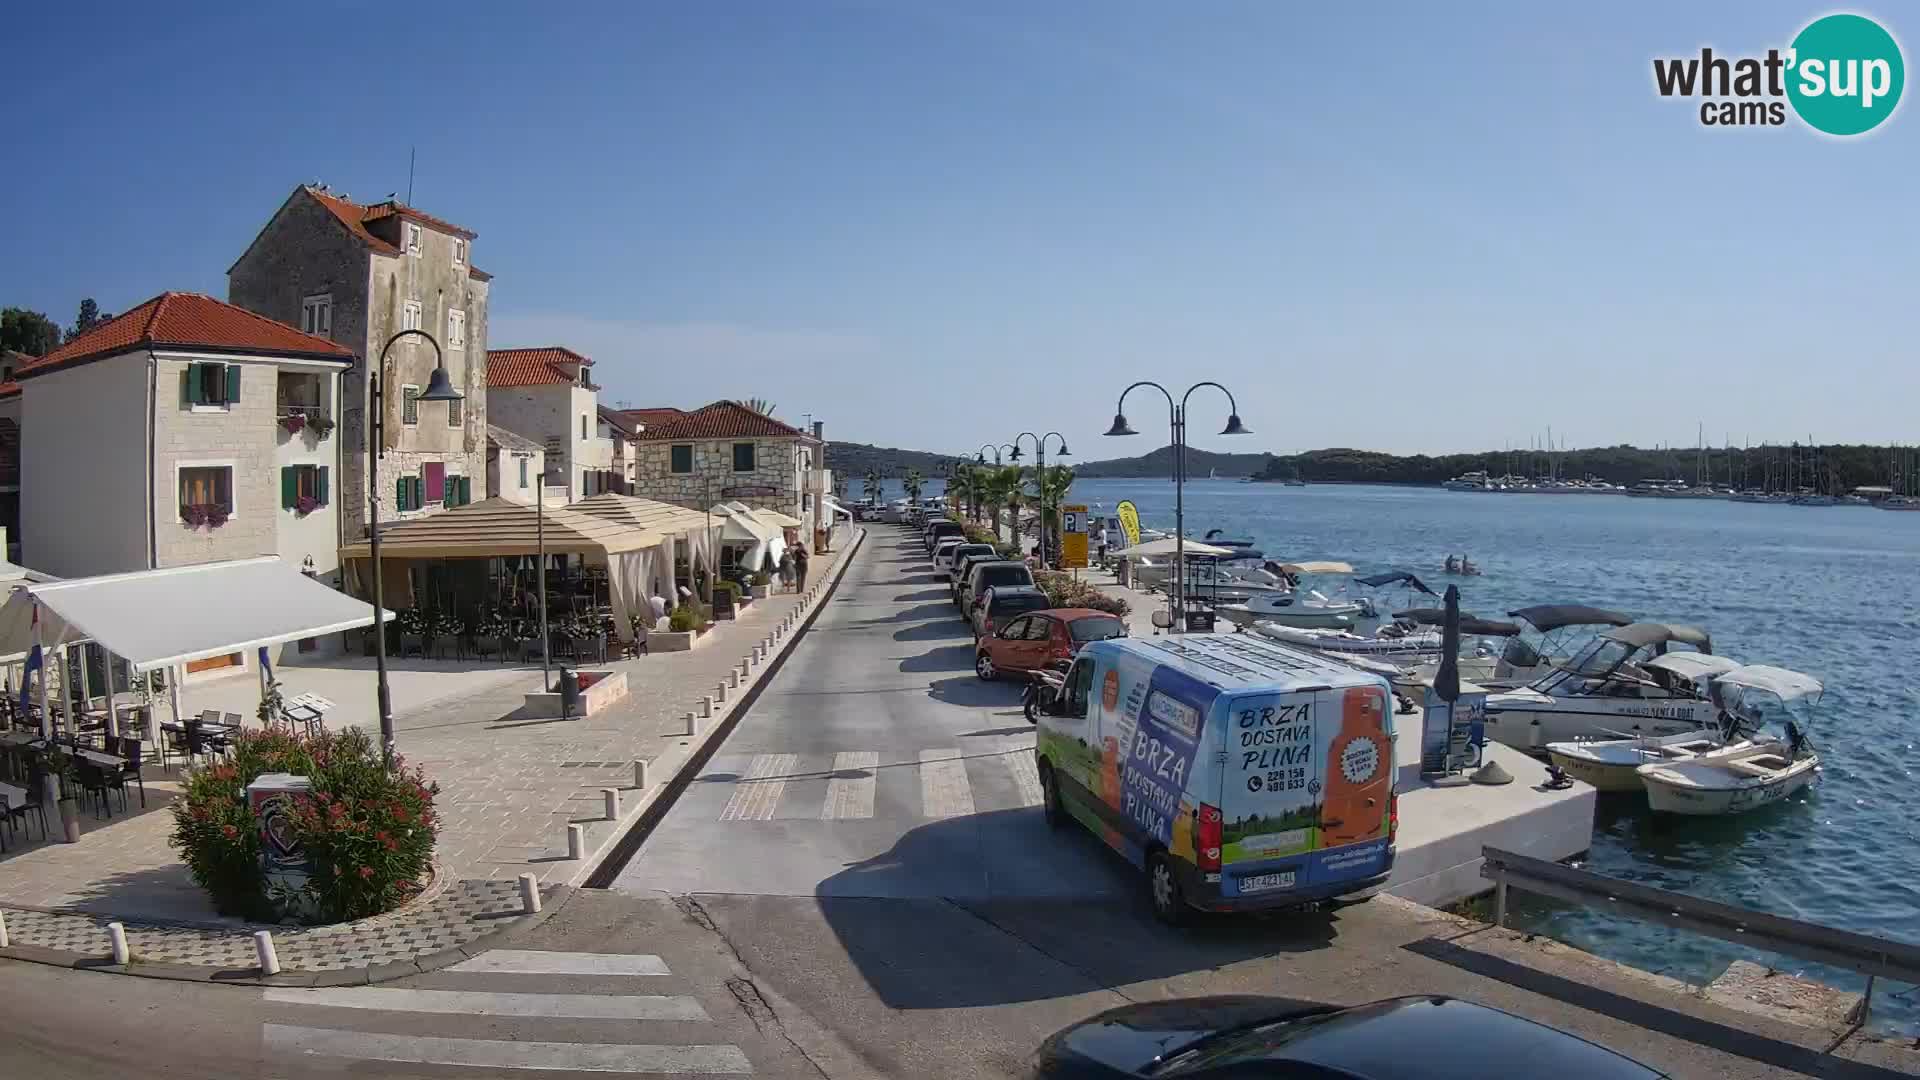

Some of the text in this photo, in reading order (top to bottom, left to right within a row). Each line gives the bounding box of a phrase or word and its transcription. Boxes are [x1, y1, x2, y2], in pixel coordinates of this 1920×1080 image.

[1064, 514, 1075, 530] P
[1240, 703, 1310, 728] BRZA
[1241, 725, 1310, 747] DOSTAVA
[1135, 730, 1186, 788] BRZA
[1241, 744, 1311, 770] PLINA
[1127, 766, 1174, 815] DOSTAVA
[1126, 791, 1165, 841] PLINA
